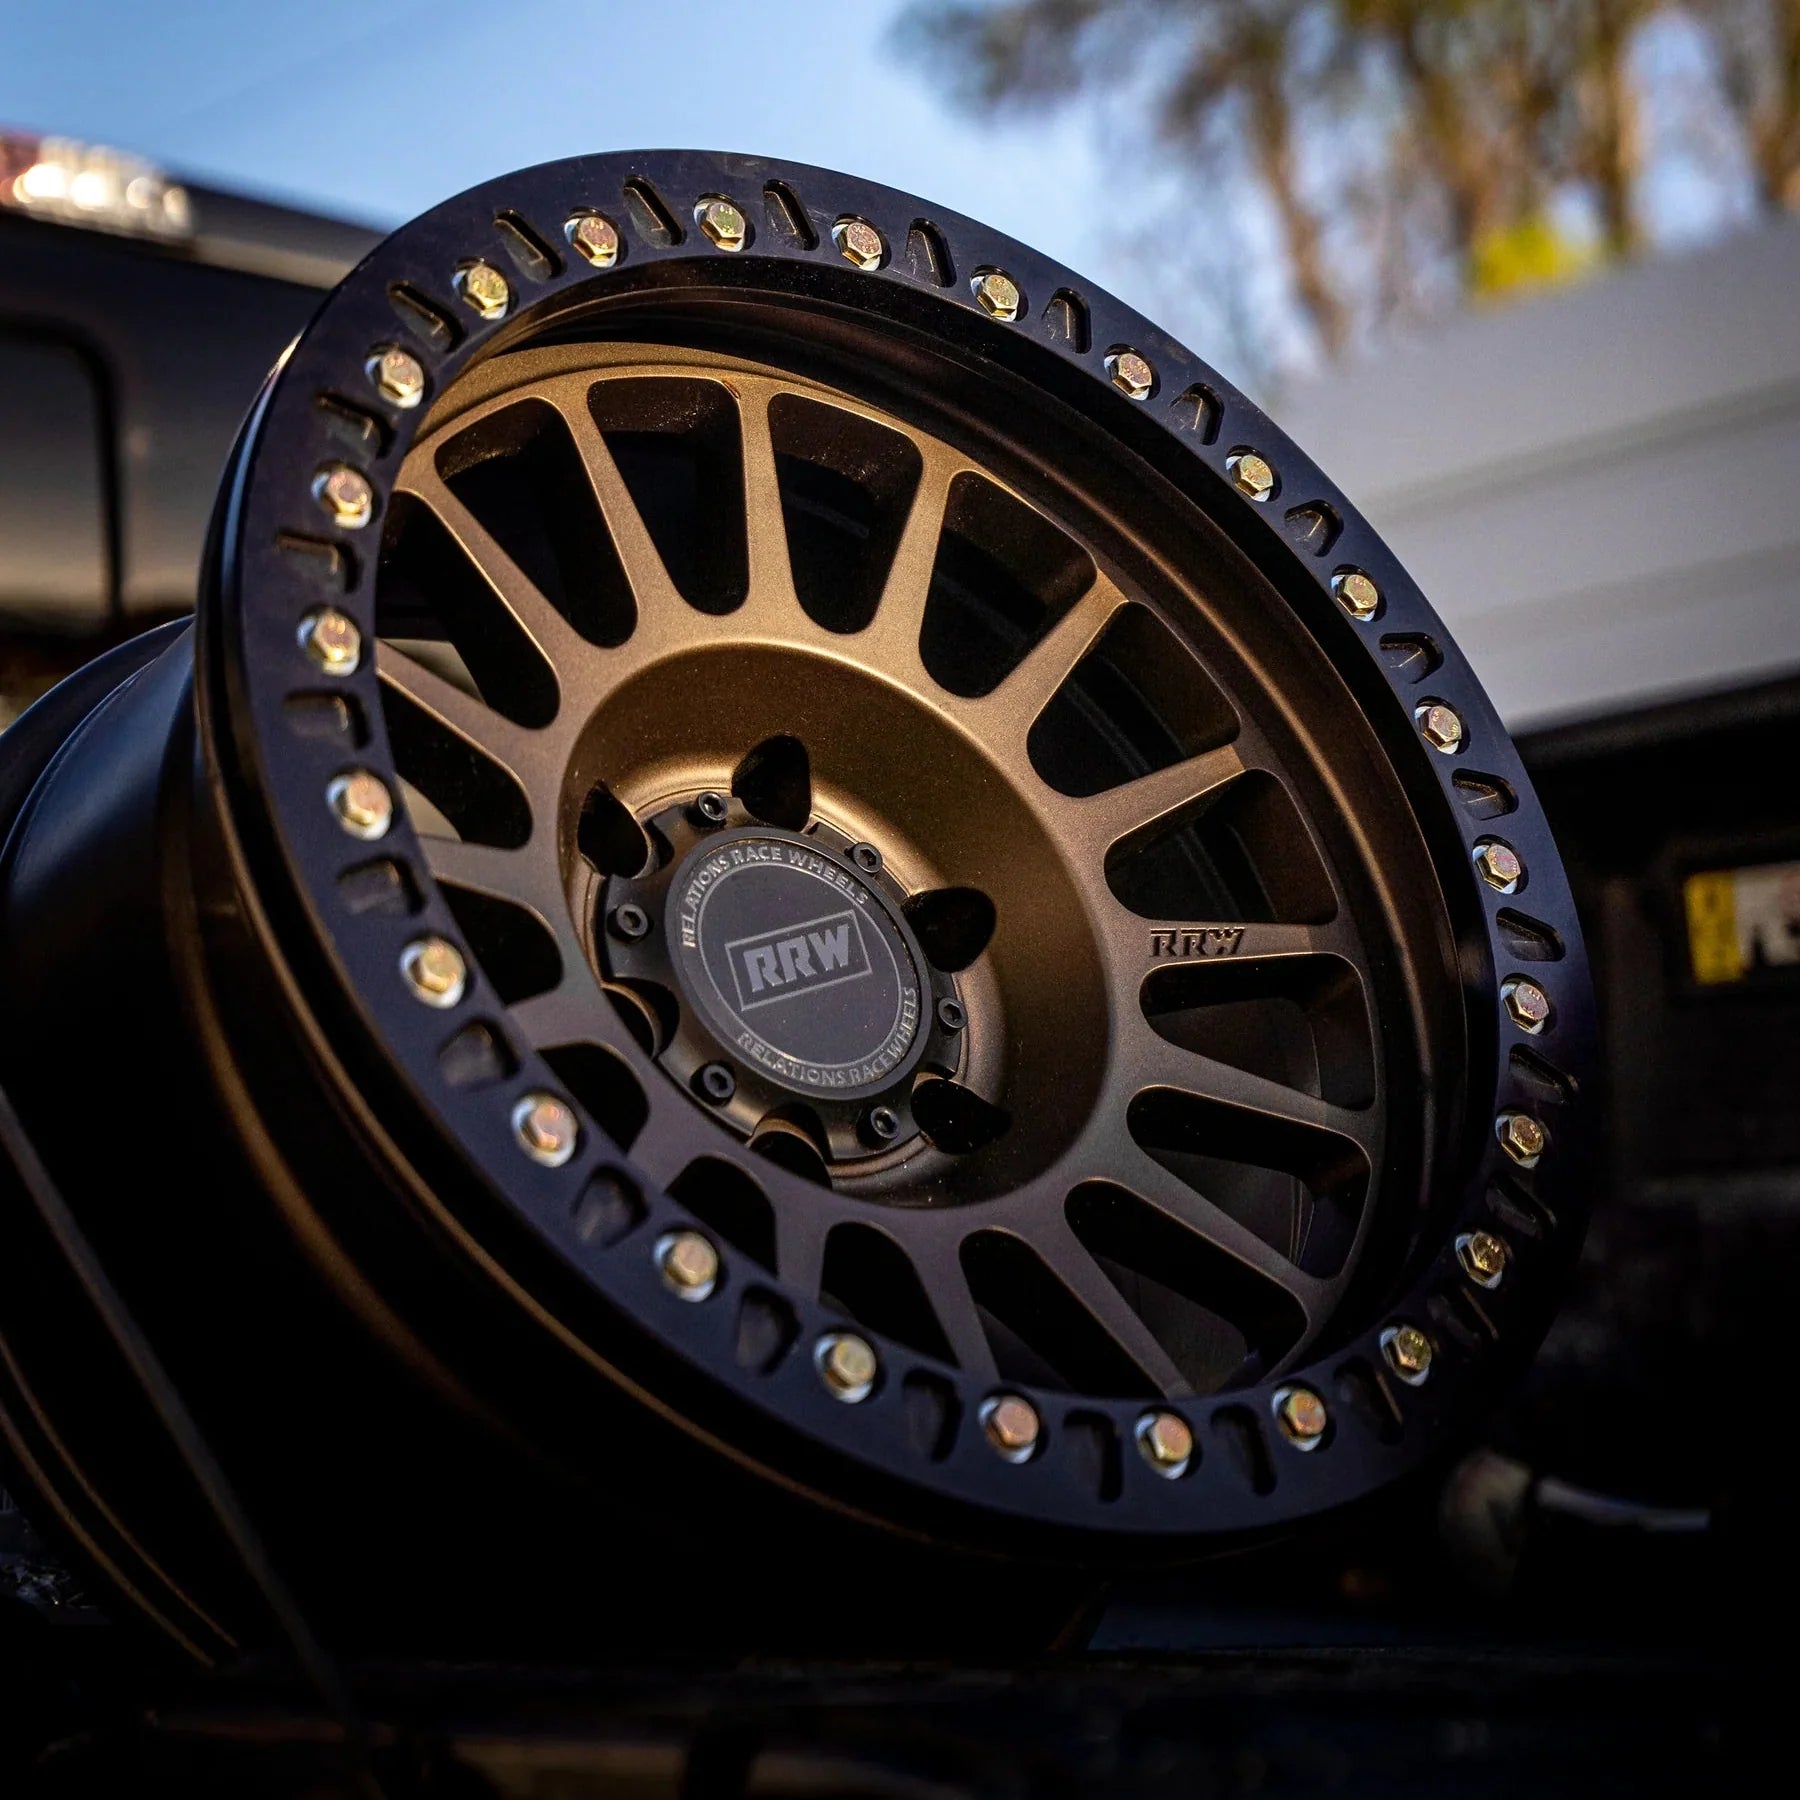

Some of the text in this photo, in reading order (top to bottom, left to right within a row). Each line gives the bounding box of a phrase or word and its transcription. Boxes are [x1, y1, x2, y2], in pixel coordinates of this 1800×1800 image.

[681, 846, 868, 948] RELATIONS RACE WHEELS
[743, 924, 850, 993] RRW
[1150, 926, 1246, 957] RRW
[737, 986, 918, 1087] RELATIONS RACE WHEELS
